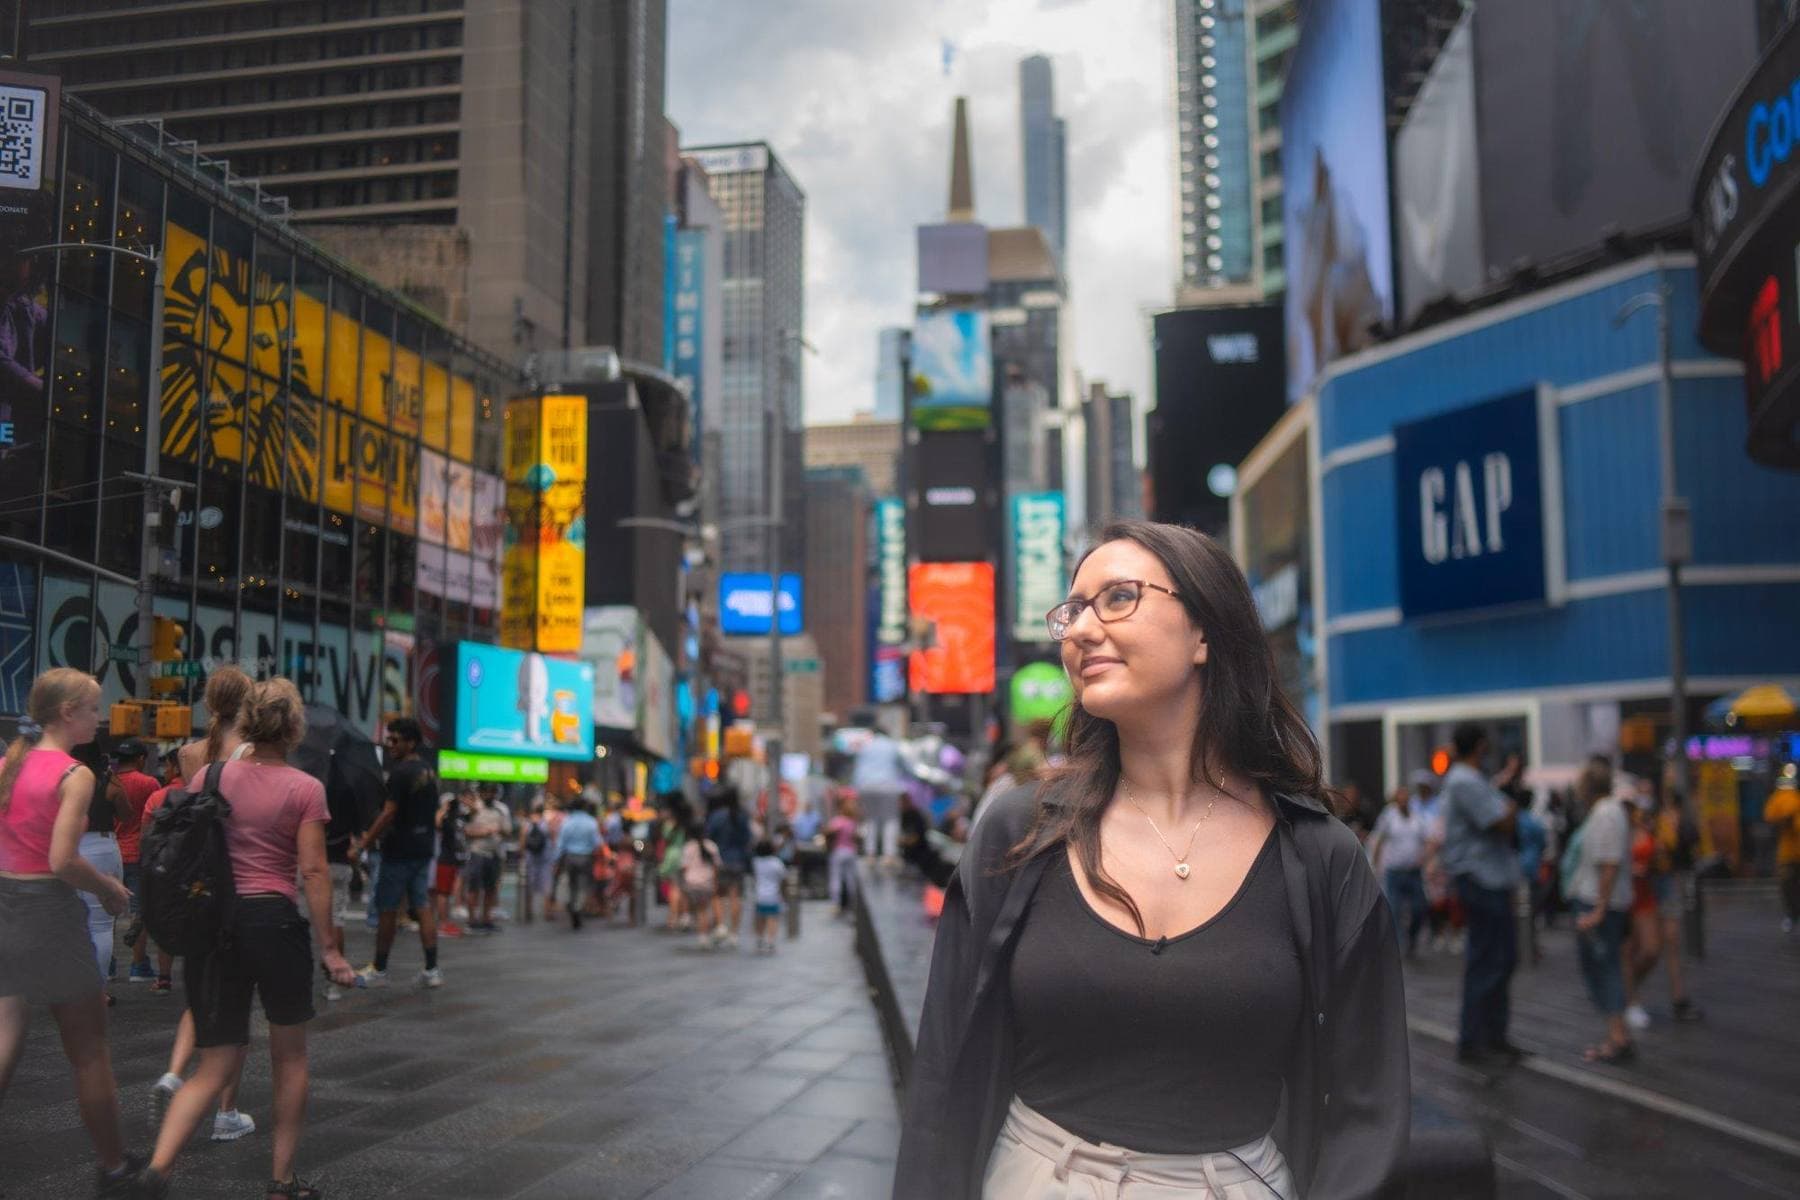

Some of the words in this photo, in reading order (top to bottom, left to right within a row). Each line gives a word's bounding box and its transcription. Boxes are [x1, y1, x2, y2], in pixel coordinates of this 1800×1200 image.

[1745, 76, 1800, 187] Co
[380, 369, 420, 420] THE
[333, 398, 399, 484] LION
[1419, 452, 1512, 564] GAP
[256, 632, 400, 722] NEWS
